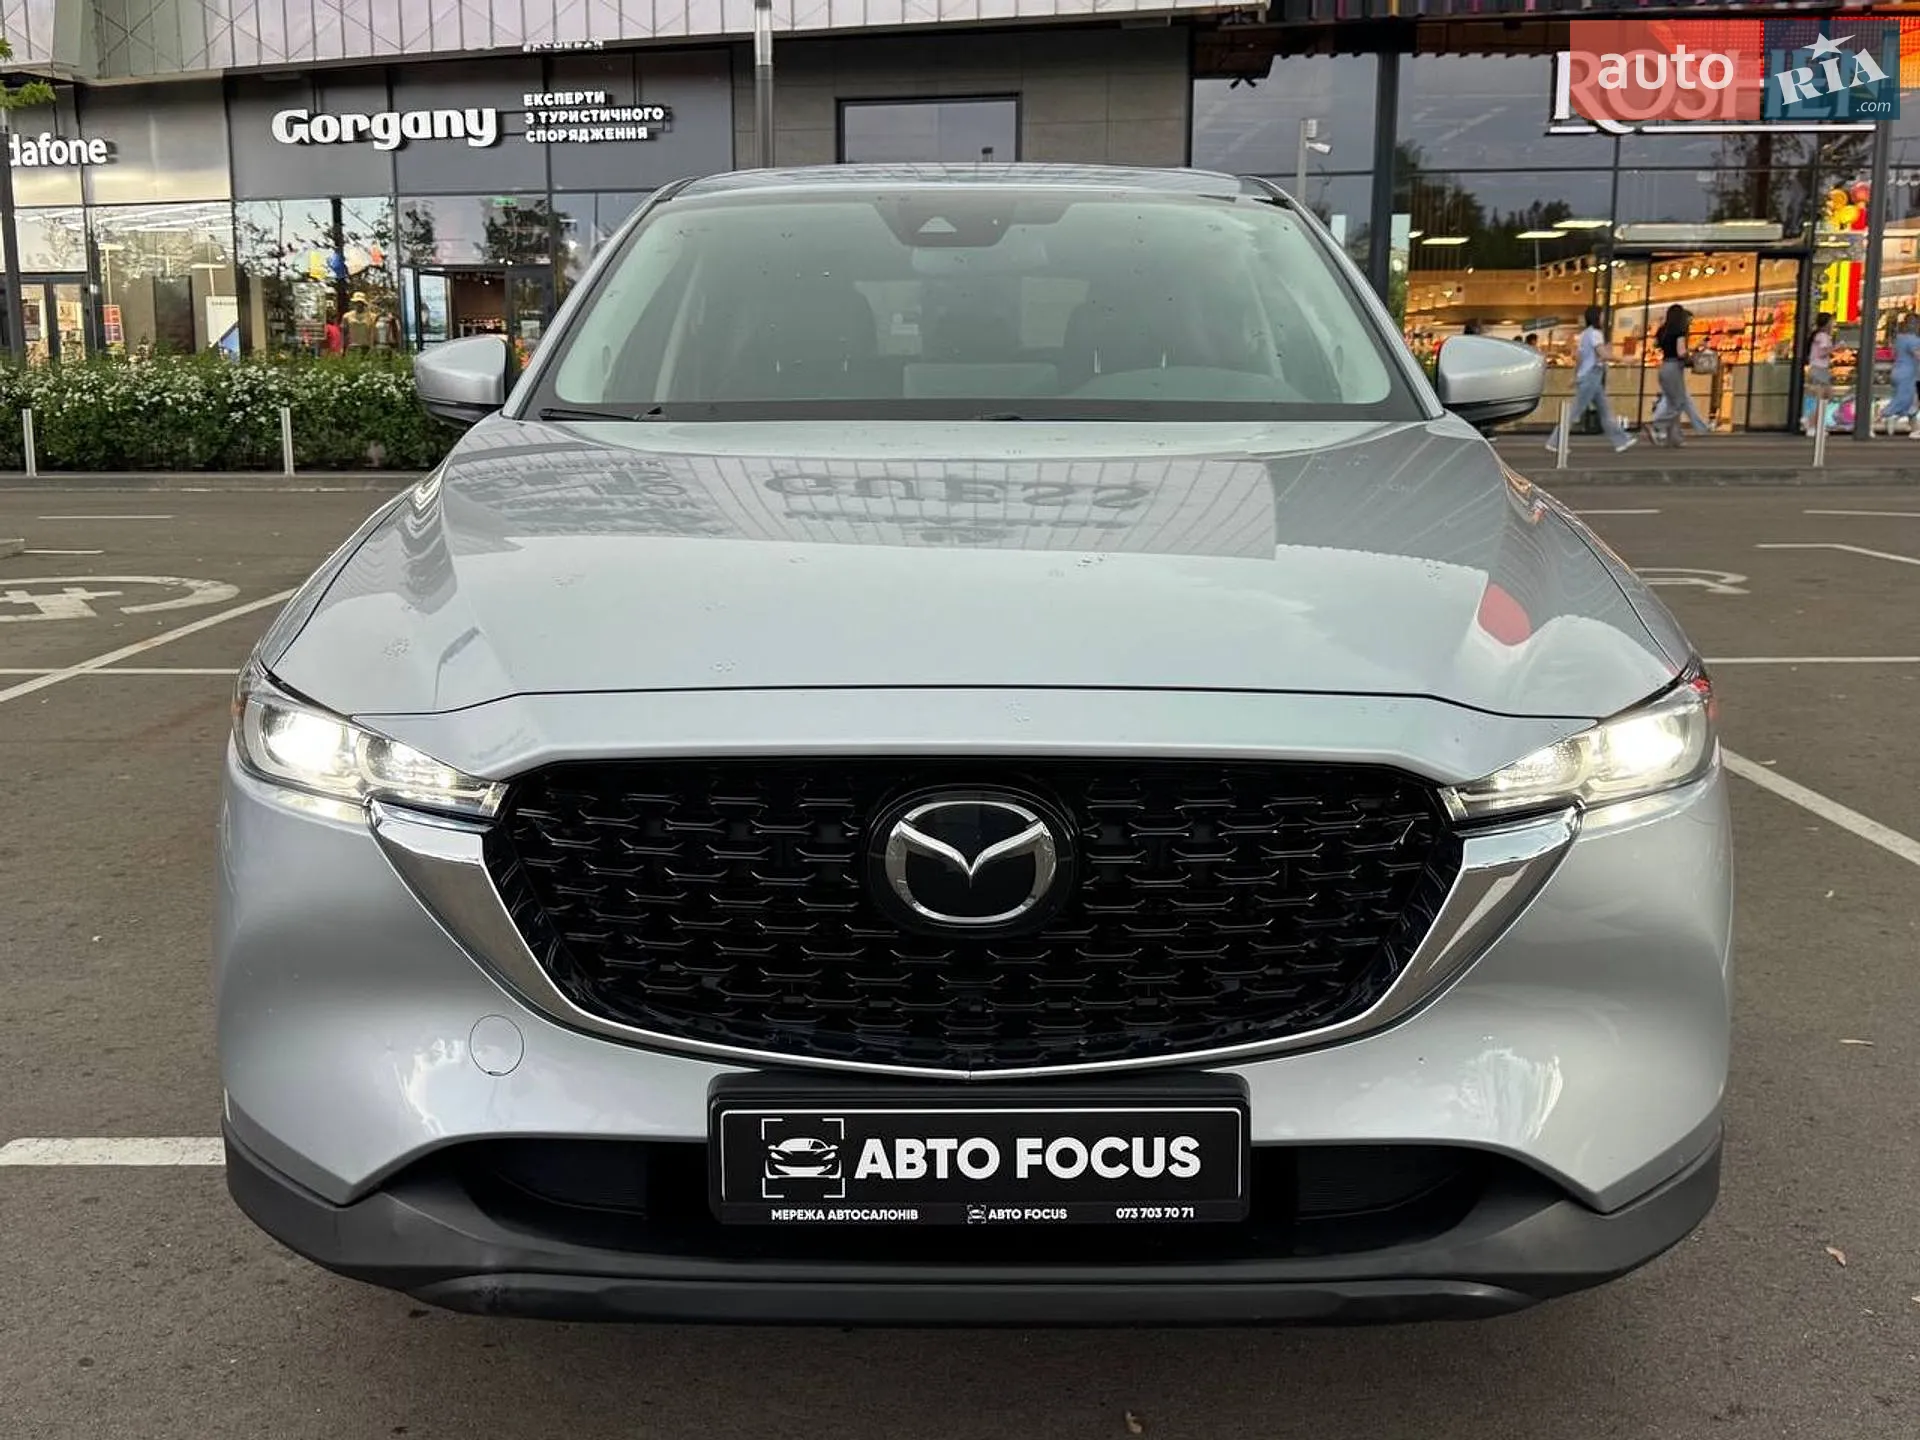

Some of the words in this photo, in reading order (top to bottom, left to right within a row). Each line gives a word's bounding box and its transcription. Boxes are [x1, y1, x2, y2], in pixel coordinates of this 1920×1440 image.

[523, 91, 606, 106] ЕКСПЕРТИ
[538, 107, 665, 124] ТУРИСТИЧНОГО
[271, 107, 497, 151] Gorgany
[525, 126, 649, 143] СПОРЯДЖЕННЯ
[854, 1137, 1001, 1180] АВТО
[1016, 1135, 1201, 1179] FOCUS
[771, 1208, 826, 1221] МЕРЕЖА
[827, 1208, 919, 1222] АВТОСАЛОНІВ
[987, 1208, 1022, 1220] АВТО
[1024, 1208, 1068, 1220] FOCUS
[1115, 1207, 1138, 1219] 073
[1139, 1207, 1162, 1219] 703
[1163, 1207, 1180, 1219] 70
[1181, 1207, 1195, 1219] 71
